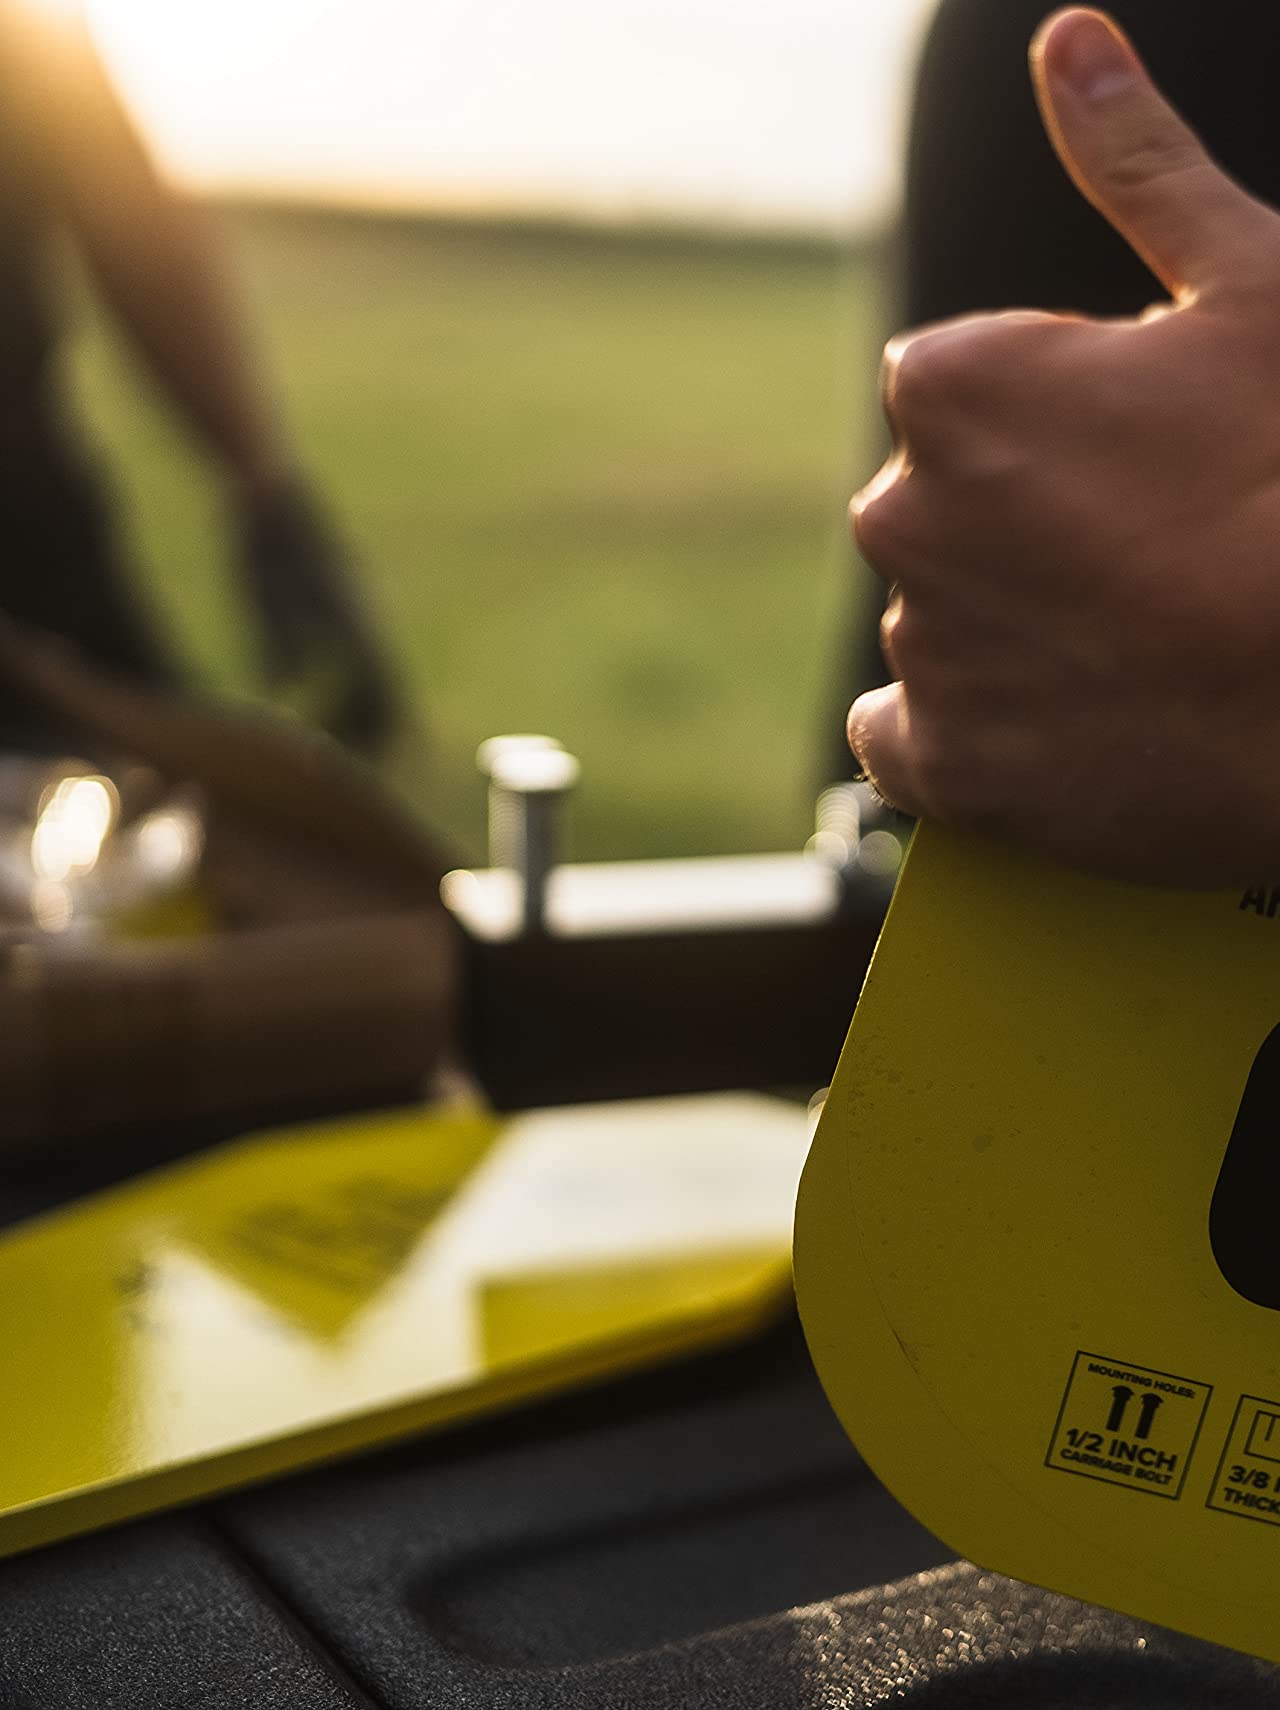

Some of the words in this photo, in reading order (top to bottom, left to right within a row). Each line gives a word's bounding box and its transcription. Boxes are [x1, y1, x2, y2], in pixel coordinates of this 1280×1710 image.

[1088, 1363, 1152, 1387] MOUNTING
[1154, 1380, 1196, 1399] HOLES:
[1061, 1449, 1132, 1476] CARRIAGE
[1135, 1468, 1173, 1485] BOLT
[1066, 1428, 1103, 1452] 1/2
[1109, 1439, 1177, 1472] INCH
[1228, 1465, 1269, 1489] 3/8
